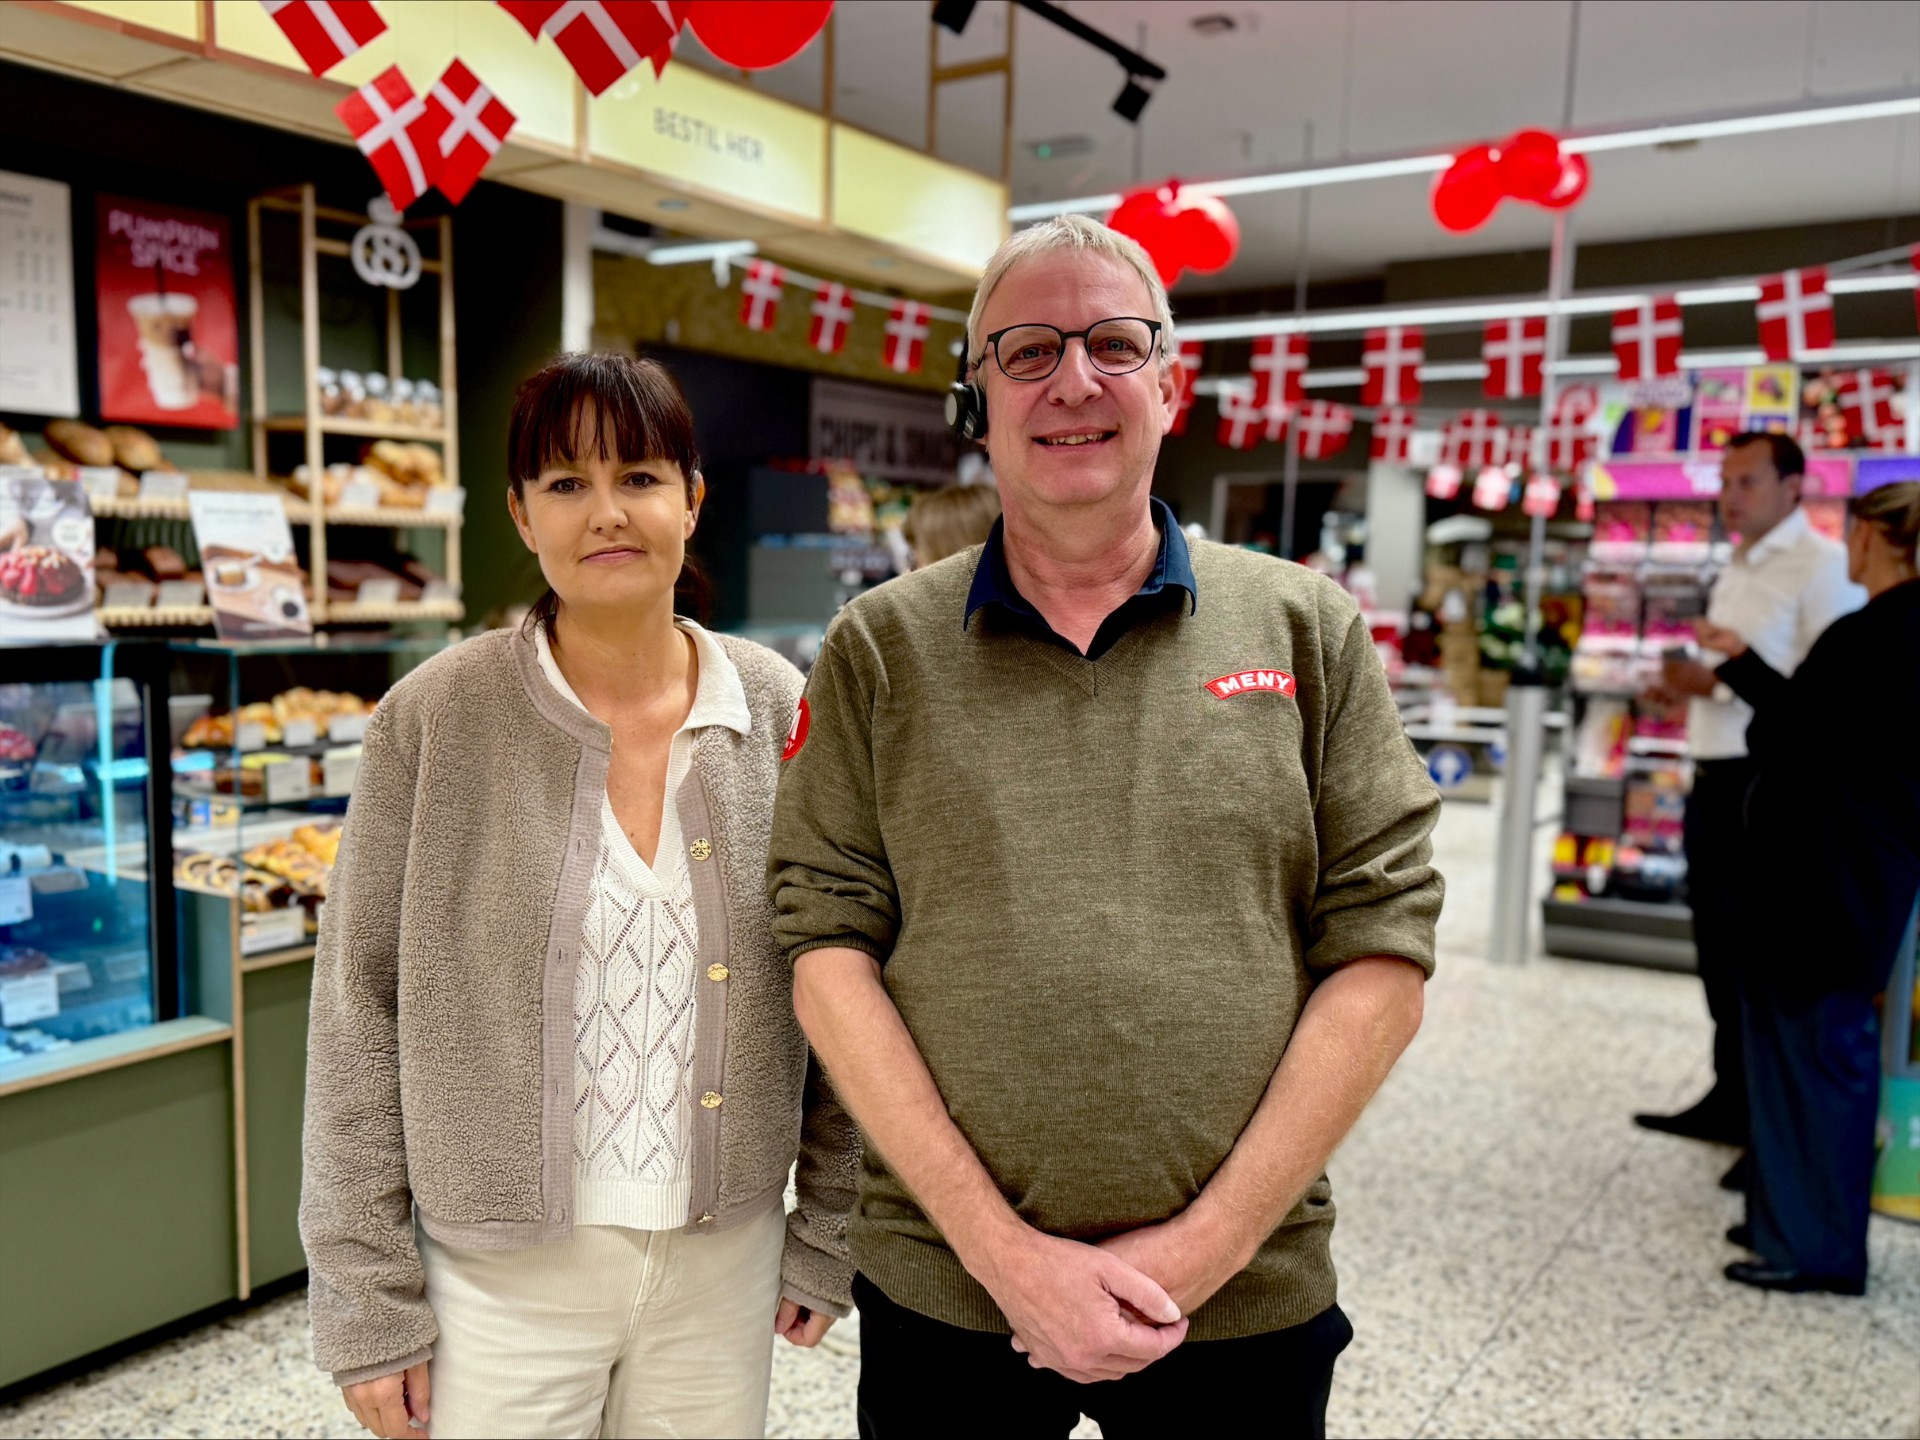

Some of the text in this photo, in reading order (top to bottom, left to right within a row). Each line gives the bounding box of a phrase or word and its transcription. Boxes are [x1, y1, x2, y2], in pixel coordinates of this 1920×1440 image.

[653, 107, 764, 164] BESTIL HER
[108, 209, 219, 251] PUMPKIN
[130, 240, 200, 276] SPICE
[1217, 671, 1290, 694] MENY
